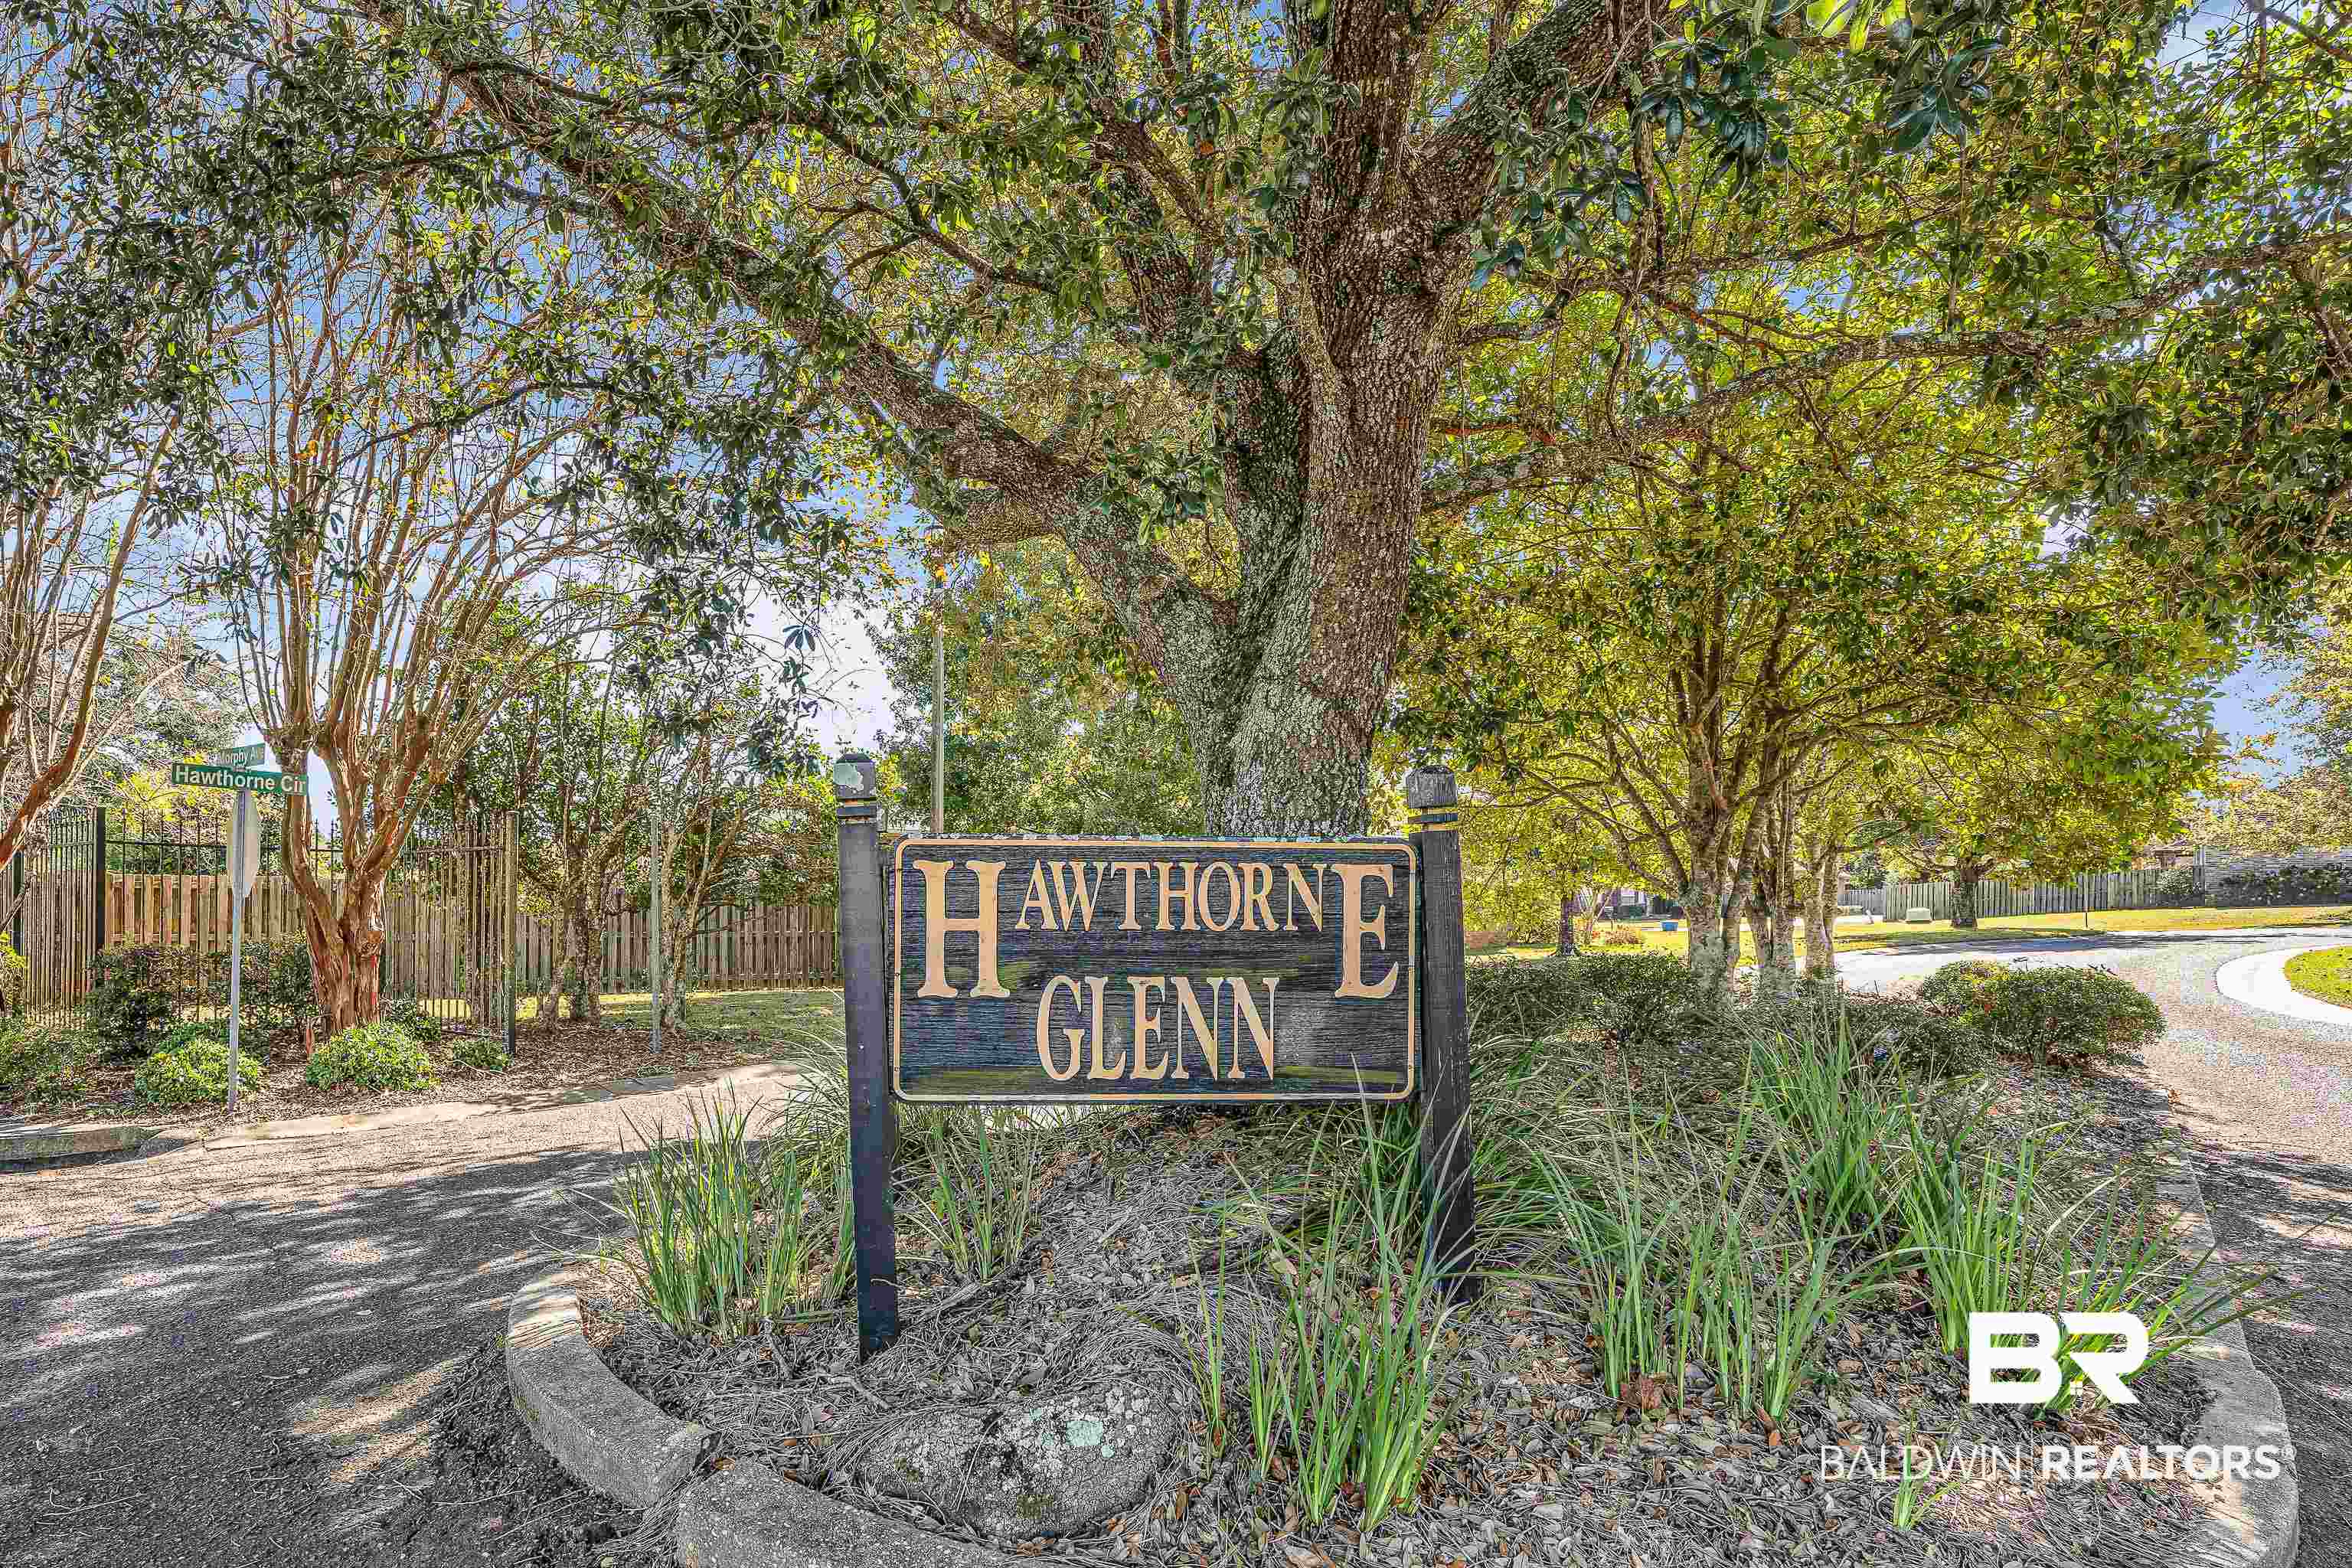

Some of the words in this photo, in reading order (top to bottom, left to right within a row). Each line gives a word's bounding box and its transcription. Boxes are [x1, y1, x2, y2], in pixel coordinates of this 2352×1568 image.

[175, 766, 276, 790] Hawthorne
[281, 773, 306, 793] Cir
[913, 860, 1400, 999] HAWTHORNE
[1036, 975, 1279, 1081] GLENN
